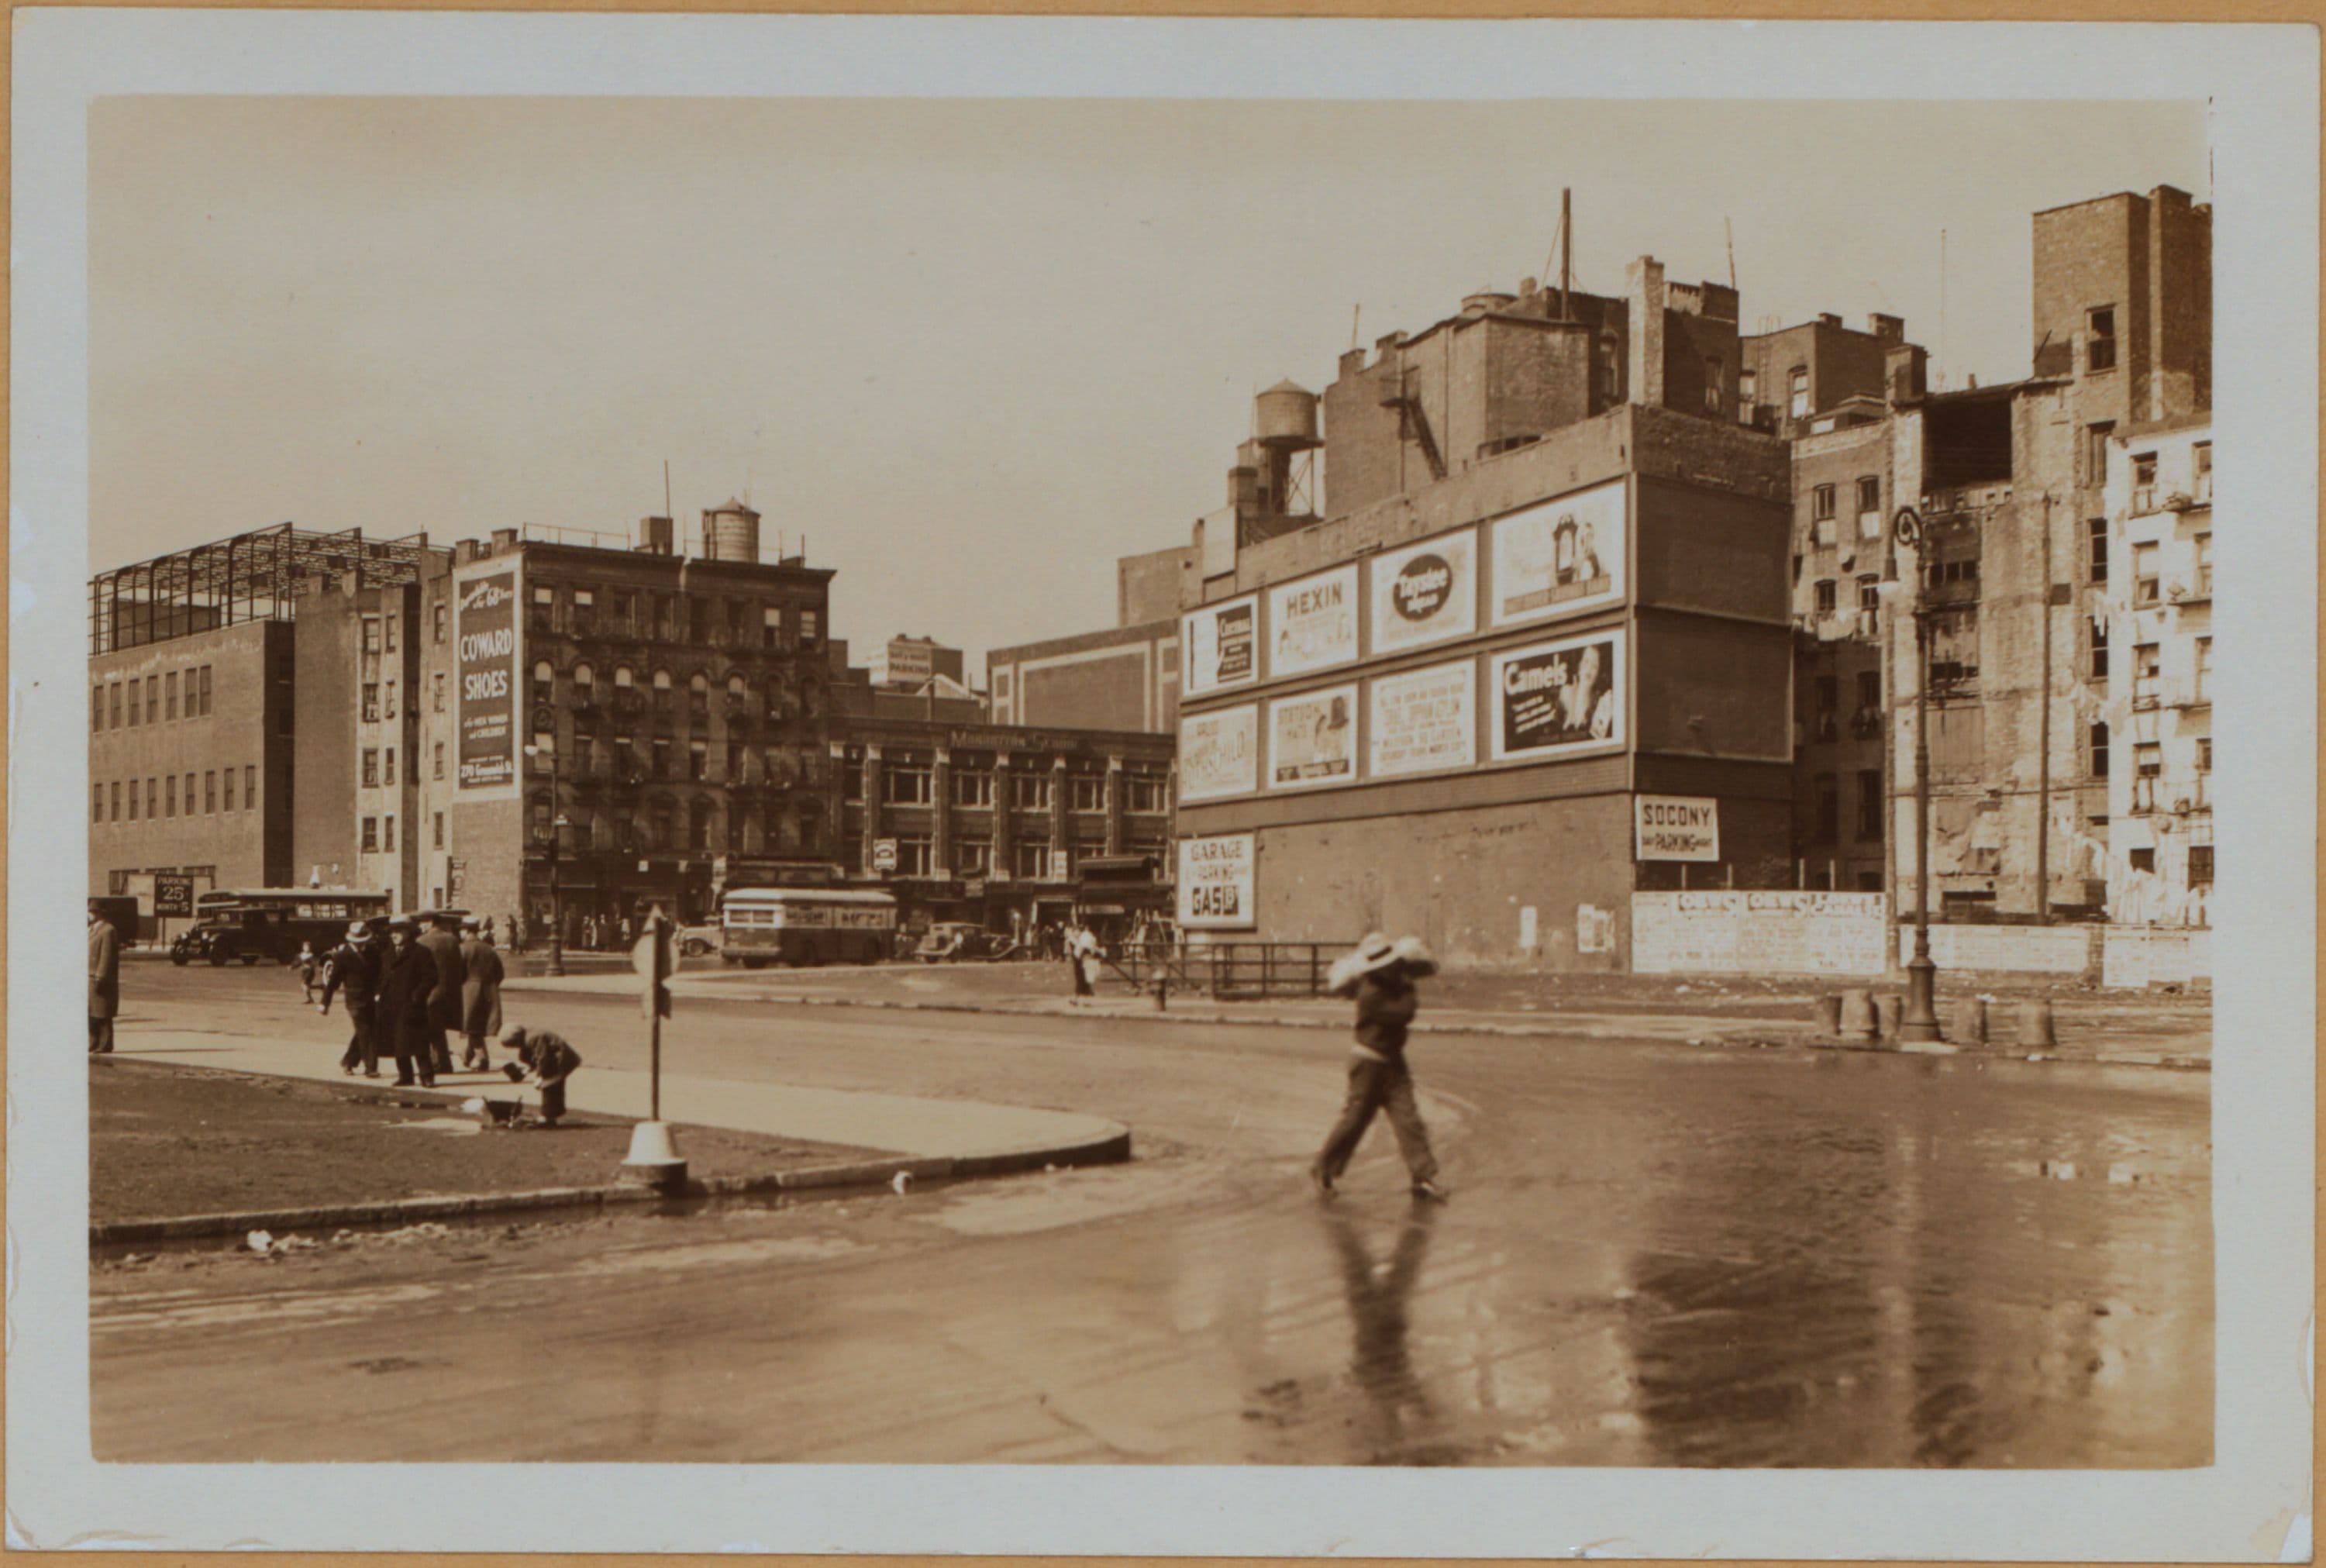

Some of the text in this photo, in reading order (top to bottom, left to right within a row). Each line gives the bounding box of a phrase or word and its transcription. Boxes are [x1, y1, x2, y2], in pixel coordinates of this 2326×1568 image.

[1286, 580, 1342, 621] HEXIN
[460, 628, 512, 662] COWARD
[464, 669, 508, 701] SHOES
[1505, 653, 1568, 696] Camels
[1643, 804, 1711, 826] SOCONY
[1191, 841, 1242, 861] GARAGE
[1656, 833, 1695, 852] PARKING
[1193, 886, 1221, 915] GAS
